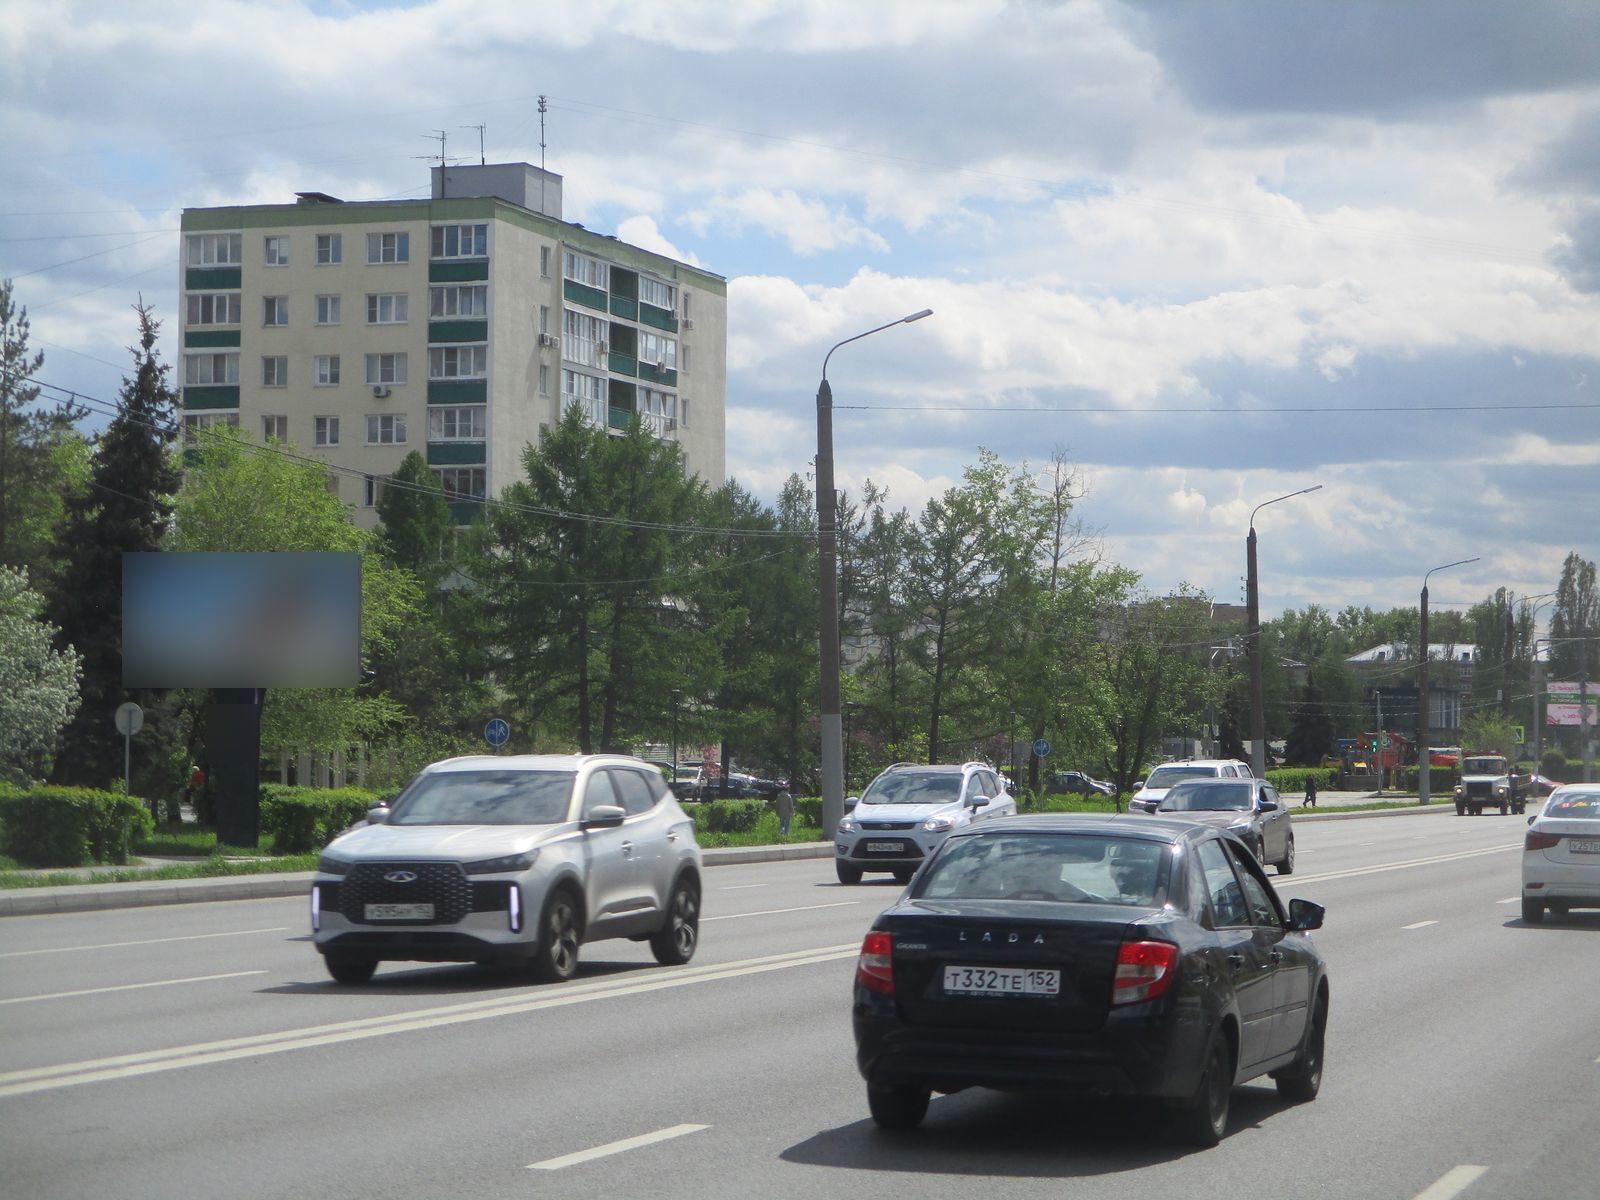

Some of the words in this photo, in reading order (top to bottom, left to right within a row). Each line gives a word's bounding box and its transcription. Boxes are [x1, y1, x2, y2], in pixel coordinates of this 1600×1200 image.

[959, 931, 1045, 944] LADA
[951, 968, 1022, 990] Т332ТЕ
[1027, 971, 1056, 987] 152
